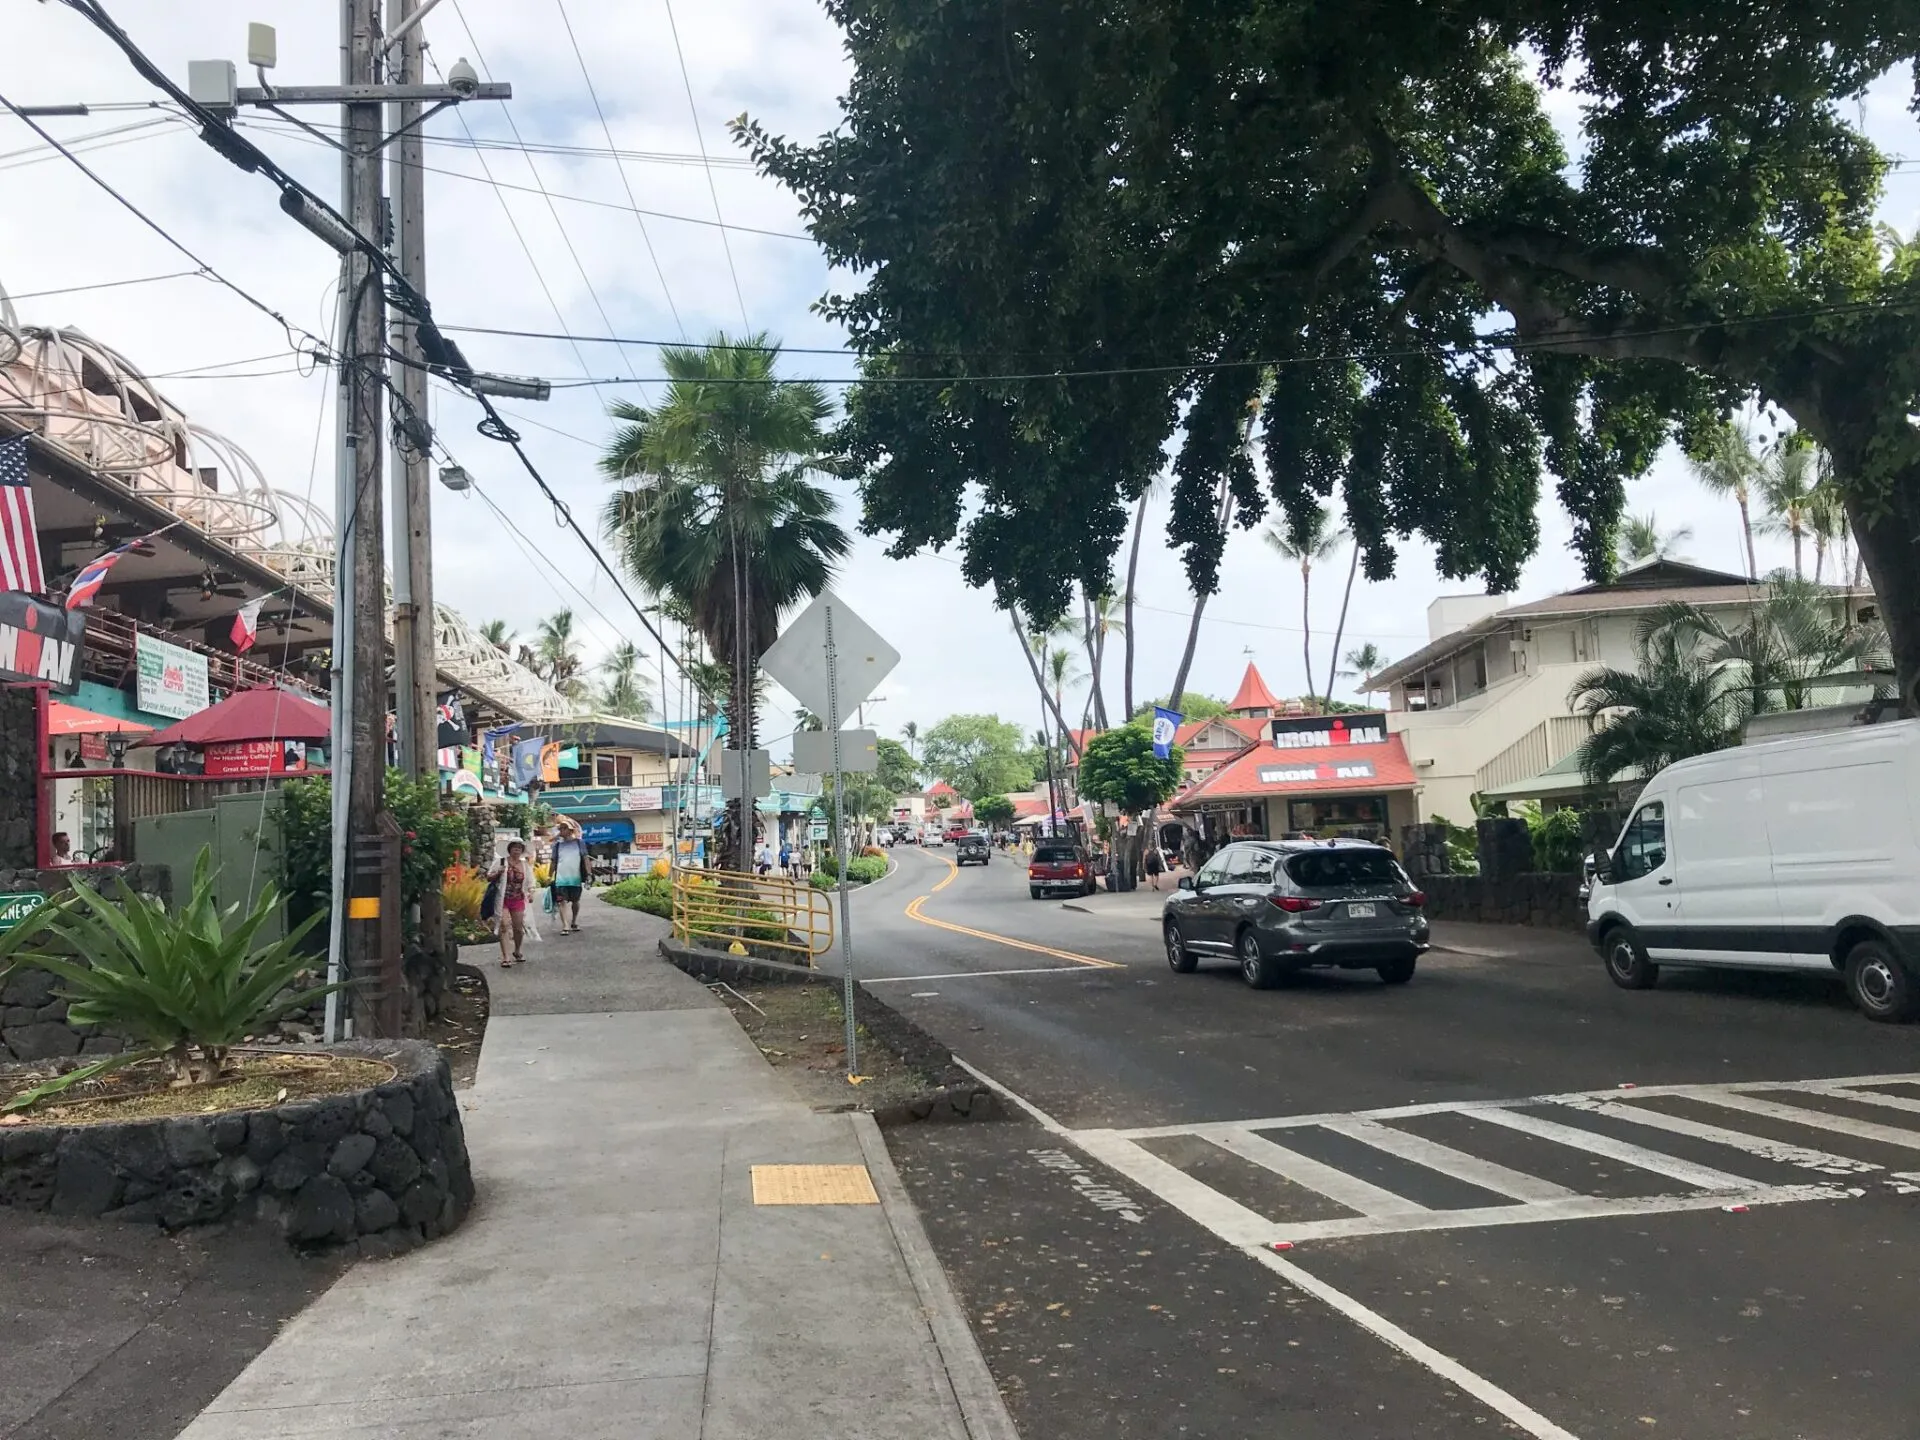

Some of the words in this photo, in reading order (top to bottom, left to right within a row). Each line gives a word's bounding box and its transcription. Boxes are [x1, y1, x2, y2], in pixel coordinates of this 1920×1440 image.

[209, 743, 243, 755] KOPE
[249, 742, 280, 754] LANI
[813, 828, 821, 837] P
[637, 834, 662, 843] PEARLS
